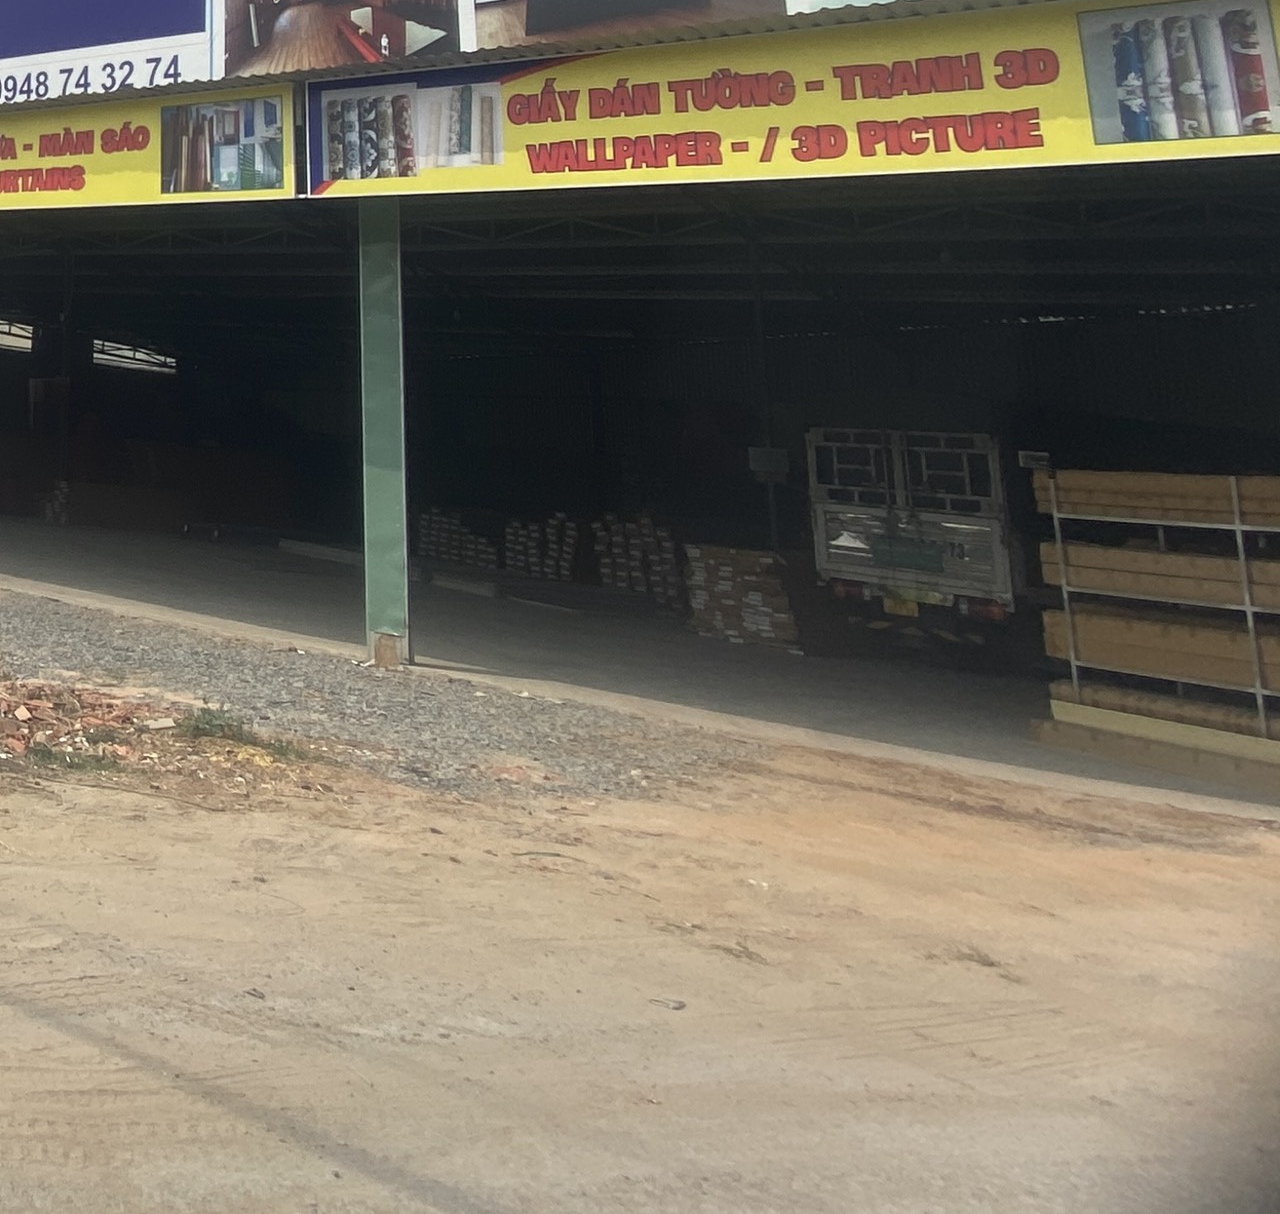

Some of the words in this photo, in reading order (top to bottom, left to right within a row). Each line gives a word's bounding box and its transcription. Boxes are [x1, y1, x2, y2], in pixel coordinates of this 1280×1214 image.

[59, 65, 91, 95] 74
[101, 60, 135, 91] 32
[145, 54, 182, 86] 74
[506, 77, 577, 125] GIẤY
[588, 77, 661, 119] DÁN
[668, 68, 796, 113] TƯỜNG
[832, 52, 984, 101] TRANH
[994, 47, 1060, 89] 3D
[38, 127, 95, 158] MÀN
[100, 121, 151, 153] SÁO
[525, 131, 722, 174] WALLPAPER
[791, 123, 848, 163] 3D
[856, 107, 1045, 158] PICTURE
